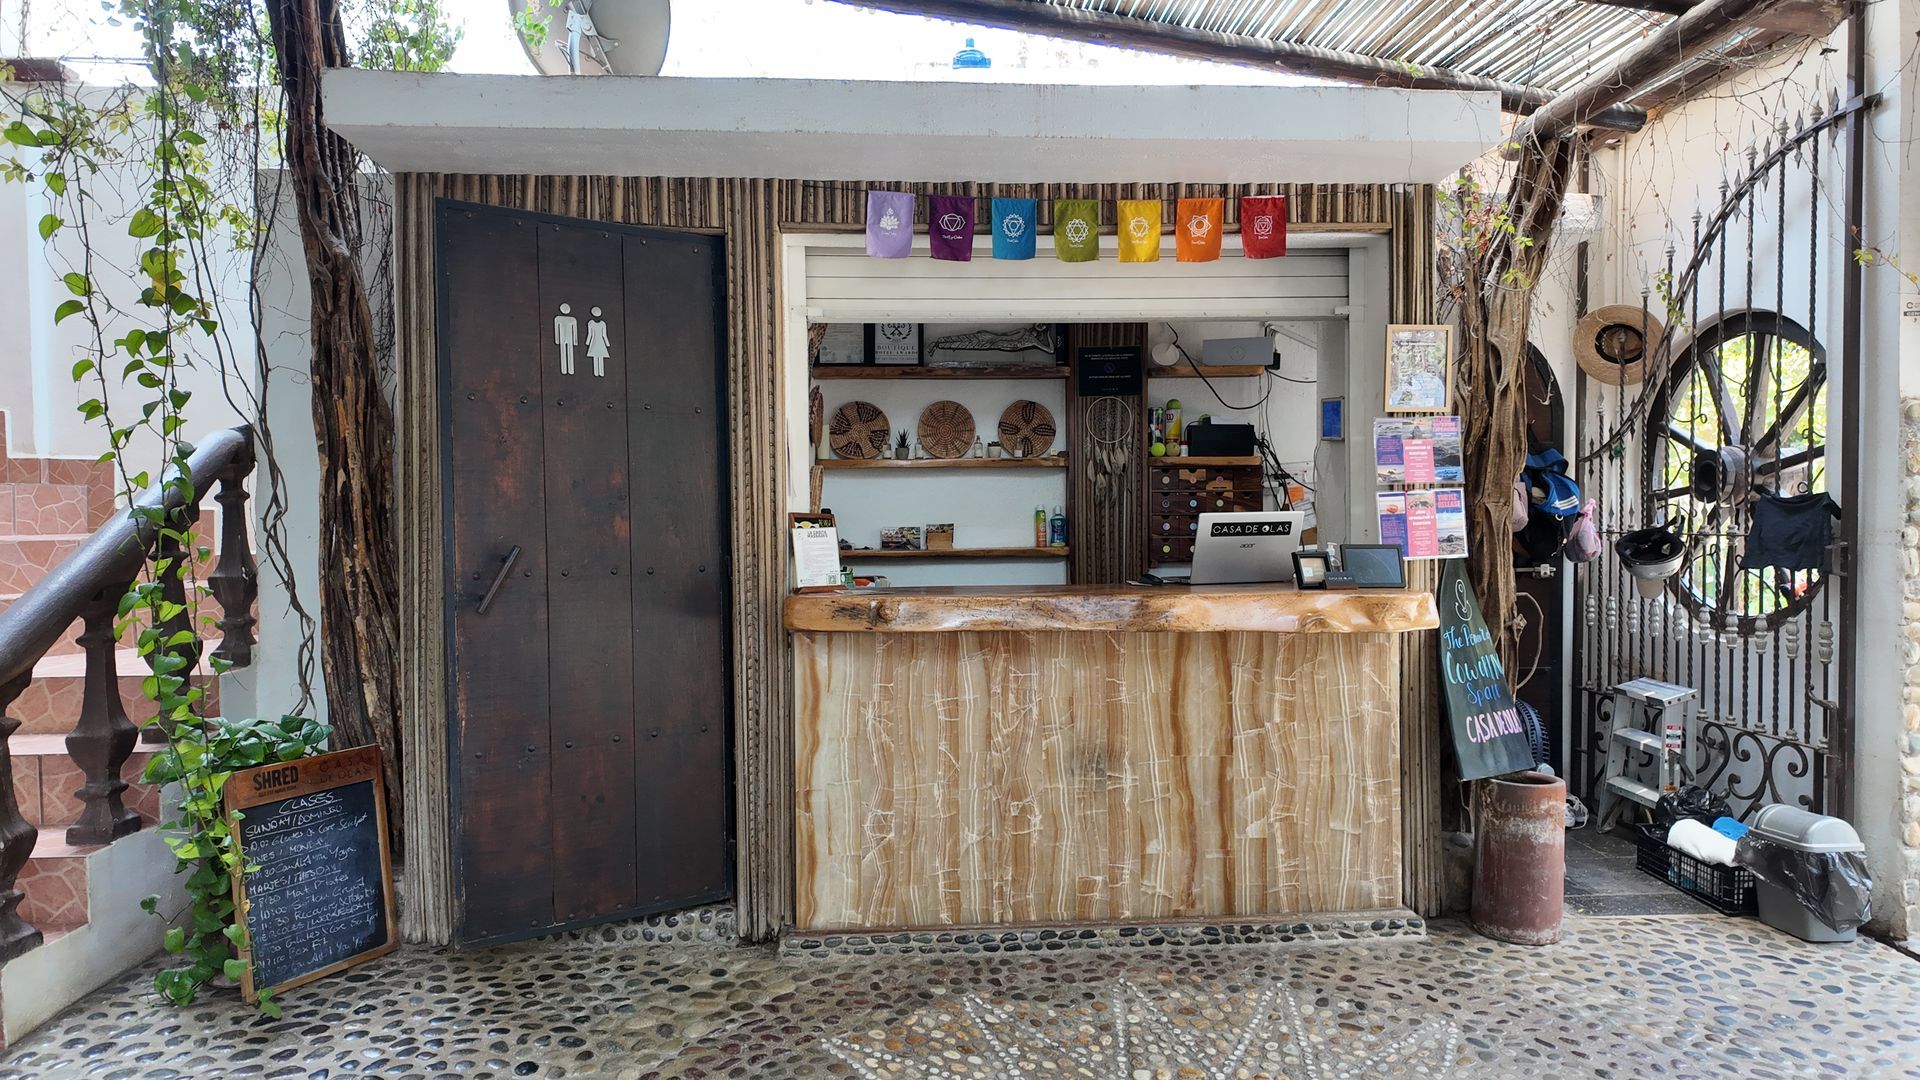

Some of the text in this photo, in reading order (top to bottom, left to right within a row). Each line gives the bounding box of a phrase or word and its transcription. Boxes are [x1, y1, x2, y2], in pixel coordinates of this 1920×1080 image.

[1212, 524, 1290, 534] CASA DE OLAS
[1442, 625, 1464, 650] The
[1466, 711, 1498, 743] CASA
[253, 765, 299, 791] SHRED
[278, 792, 335, 815] CLASES
